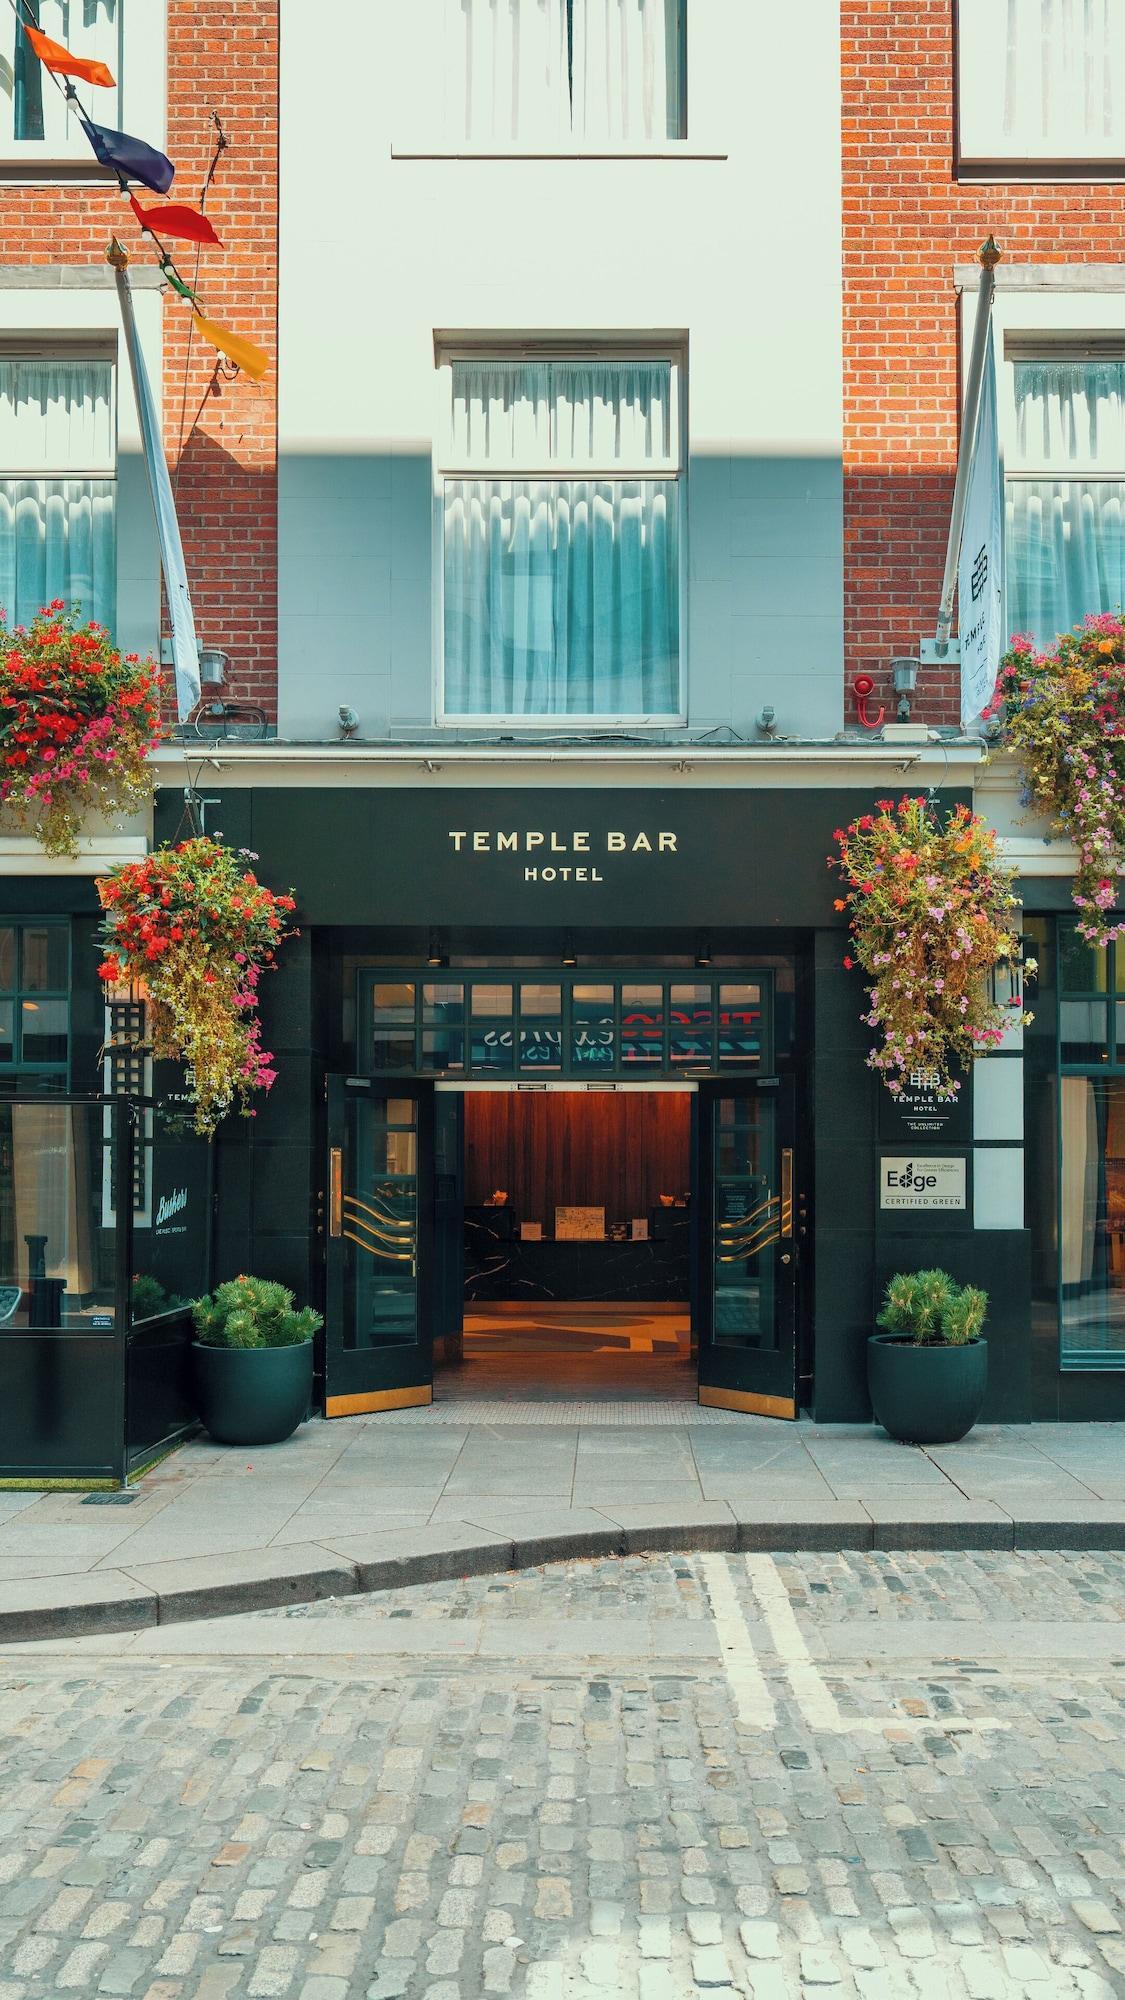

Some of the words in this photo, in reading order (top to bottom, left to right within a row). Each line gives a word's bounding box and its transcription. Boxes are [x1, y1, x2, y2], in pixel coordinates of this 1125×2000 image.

[449, 832, 590, 851] TEMPLE
[607, 832, 678, 851] BAR
[524, 867, 603, 881] HOTEL
[887, 1163, 937, 1192] Edge
